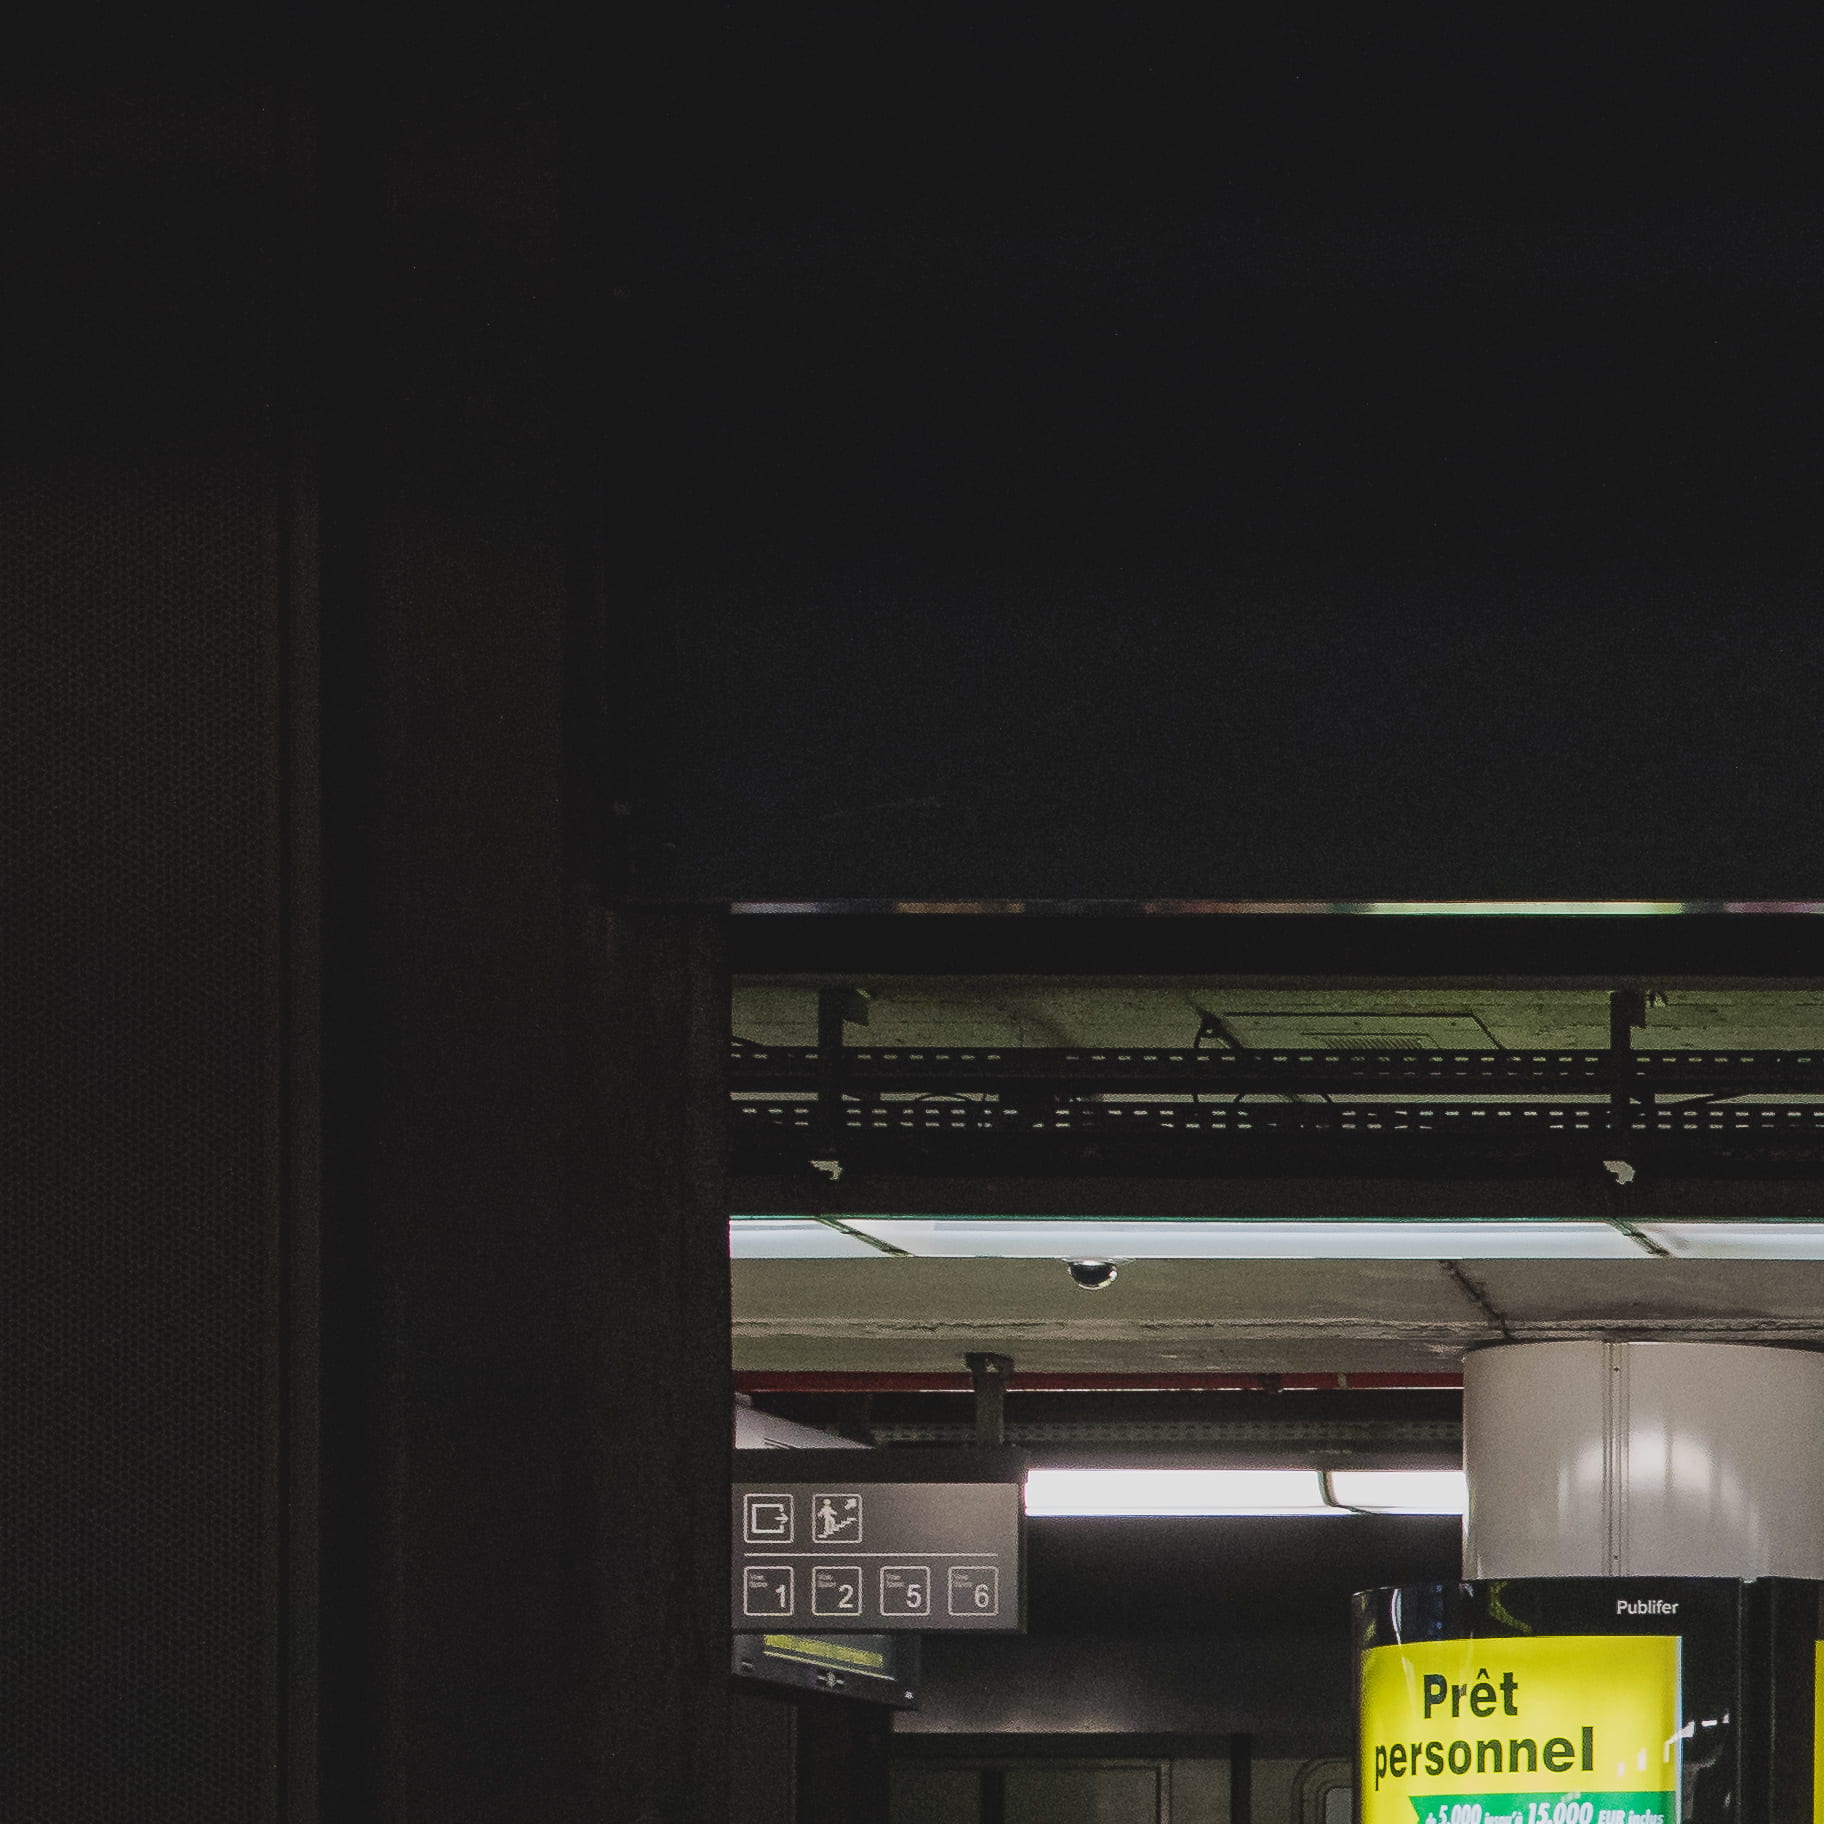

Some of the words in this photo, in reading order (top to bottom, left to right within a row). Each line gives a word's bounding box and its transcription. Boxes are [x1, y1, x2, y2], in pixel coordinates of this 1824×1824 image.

[775, 1584, 787, 1608] 1
[838, 1584, 854, 1608] 2
[905, 1584, 922, 1608] 5
[973, 1584, 989, 1608] 6
[1616, 1599, 1680, 1615] Publifer
[1424, 1668, 1518, 1719] Prêt
[1375, 1726, 1594, 1791] personnel
